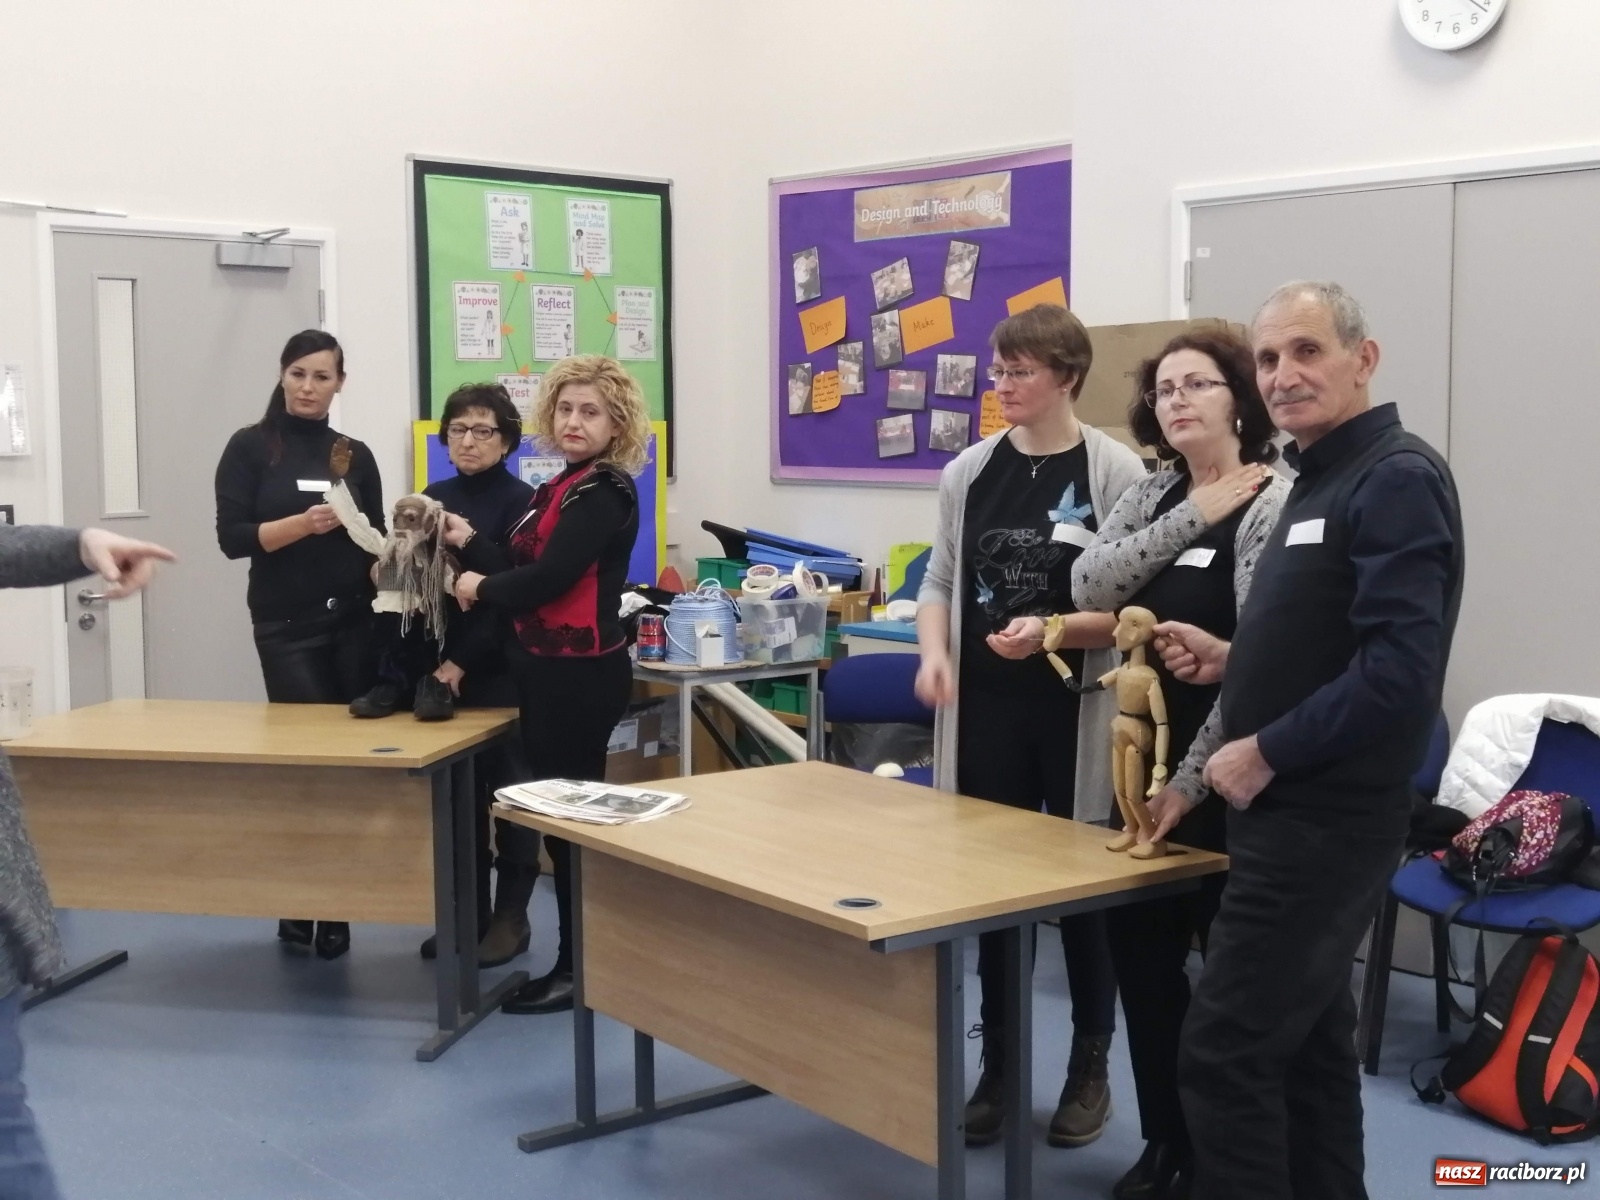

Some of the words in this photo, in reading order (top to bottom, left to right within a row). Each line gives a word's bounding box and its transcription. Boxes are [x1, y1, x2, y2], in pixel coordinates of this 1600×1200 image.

[1422, 10, 1429, 22] 8
[1471, 13, 1479, 25] 5
[1435, 21, 1442, 33] 7
[1453, 22, 1460, 34] 6
[500, 206, 520, 217] Ask
[861, 207, 901, 225] Design
[904, 200, 928, 218] and
[931, 194, 1003, 217] Technology
[572, 211, 589, 220] Mind
[591, 213, 605, 222] Map
[458, 295, 498, 308] Improve
[537, 297, 571, 311] Reflect
[621, 299, 636, 307] Plan
[638, 300, 650, 308] and
[809, 320, 833, 336] Design
[912, 318, 935, 333] Make
[509, 387, 530, 398] Test
